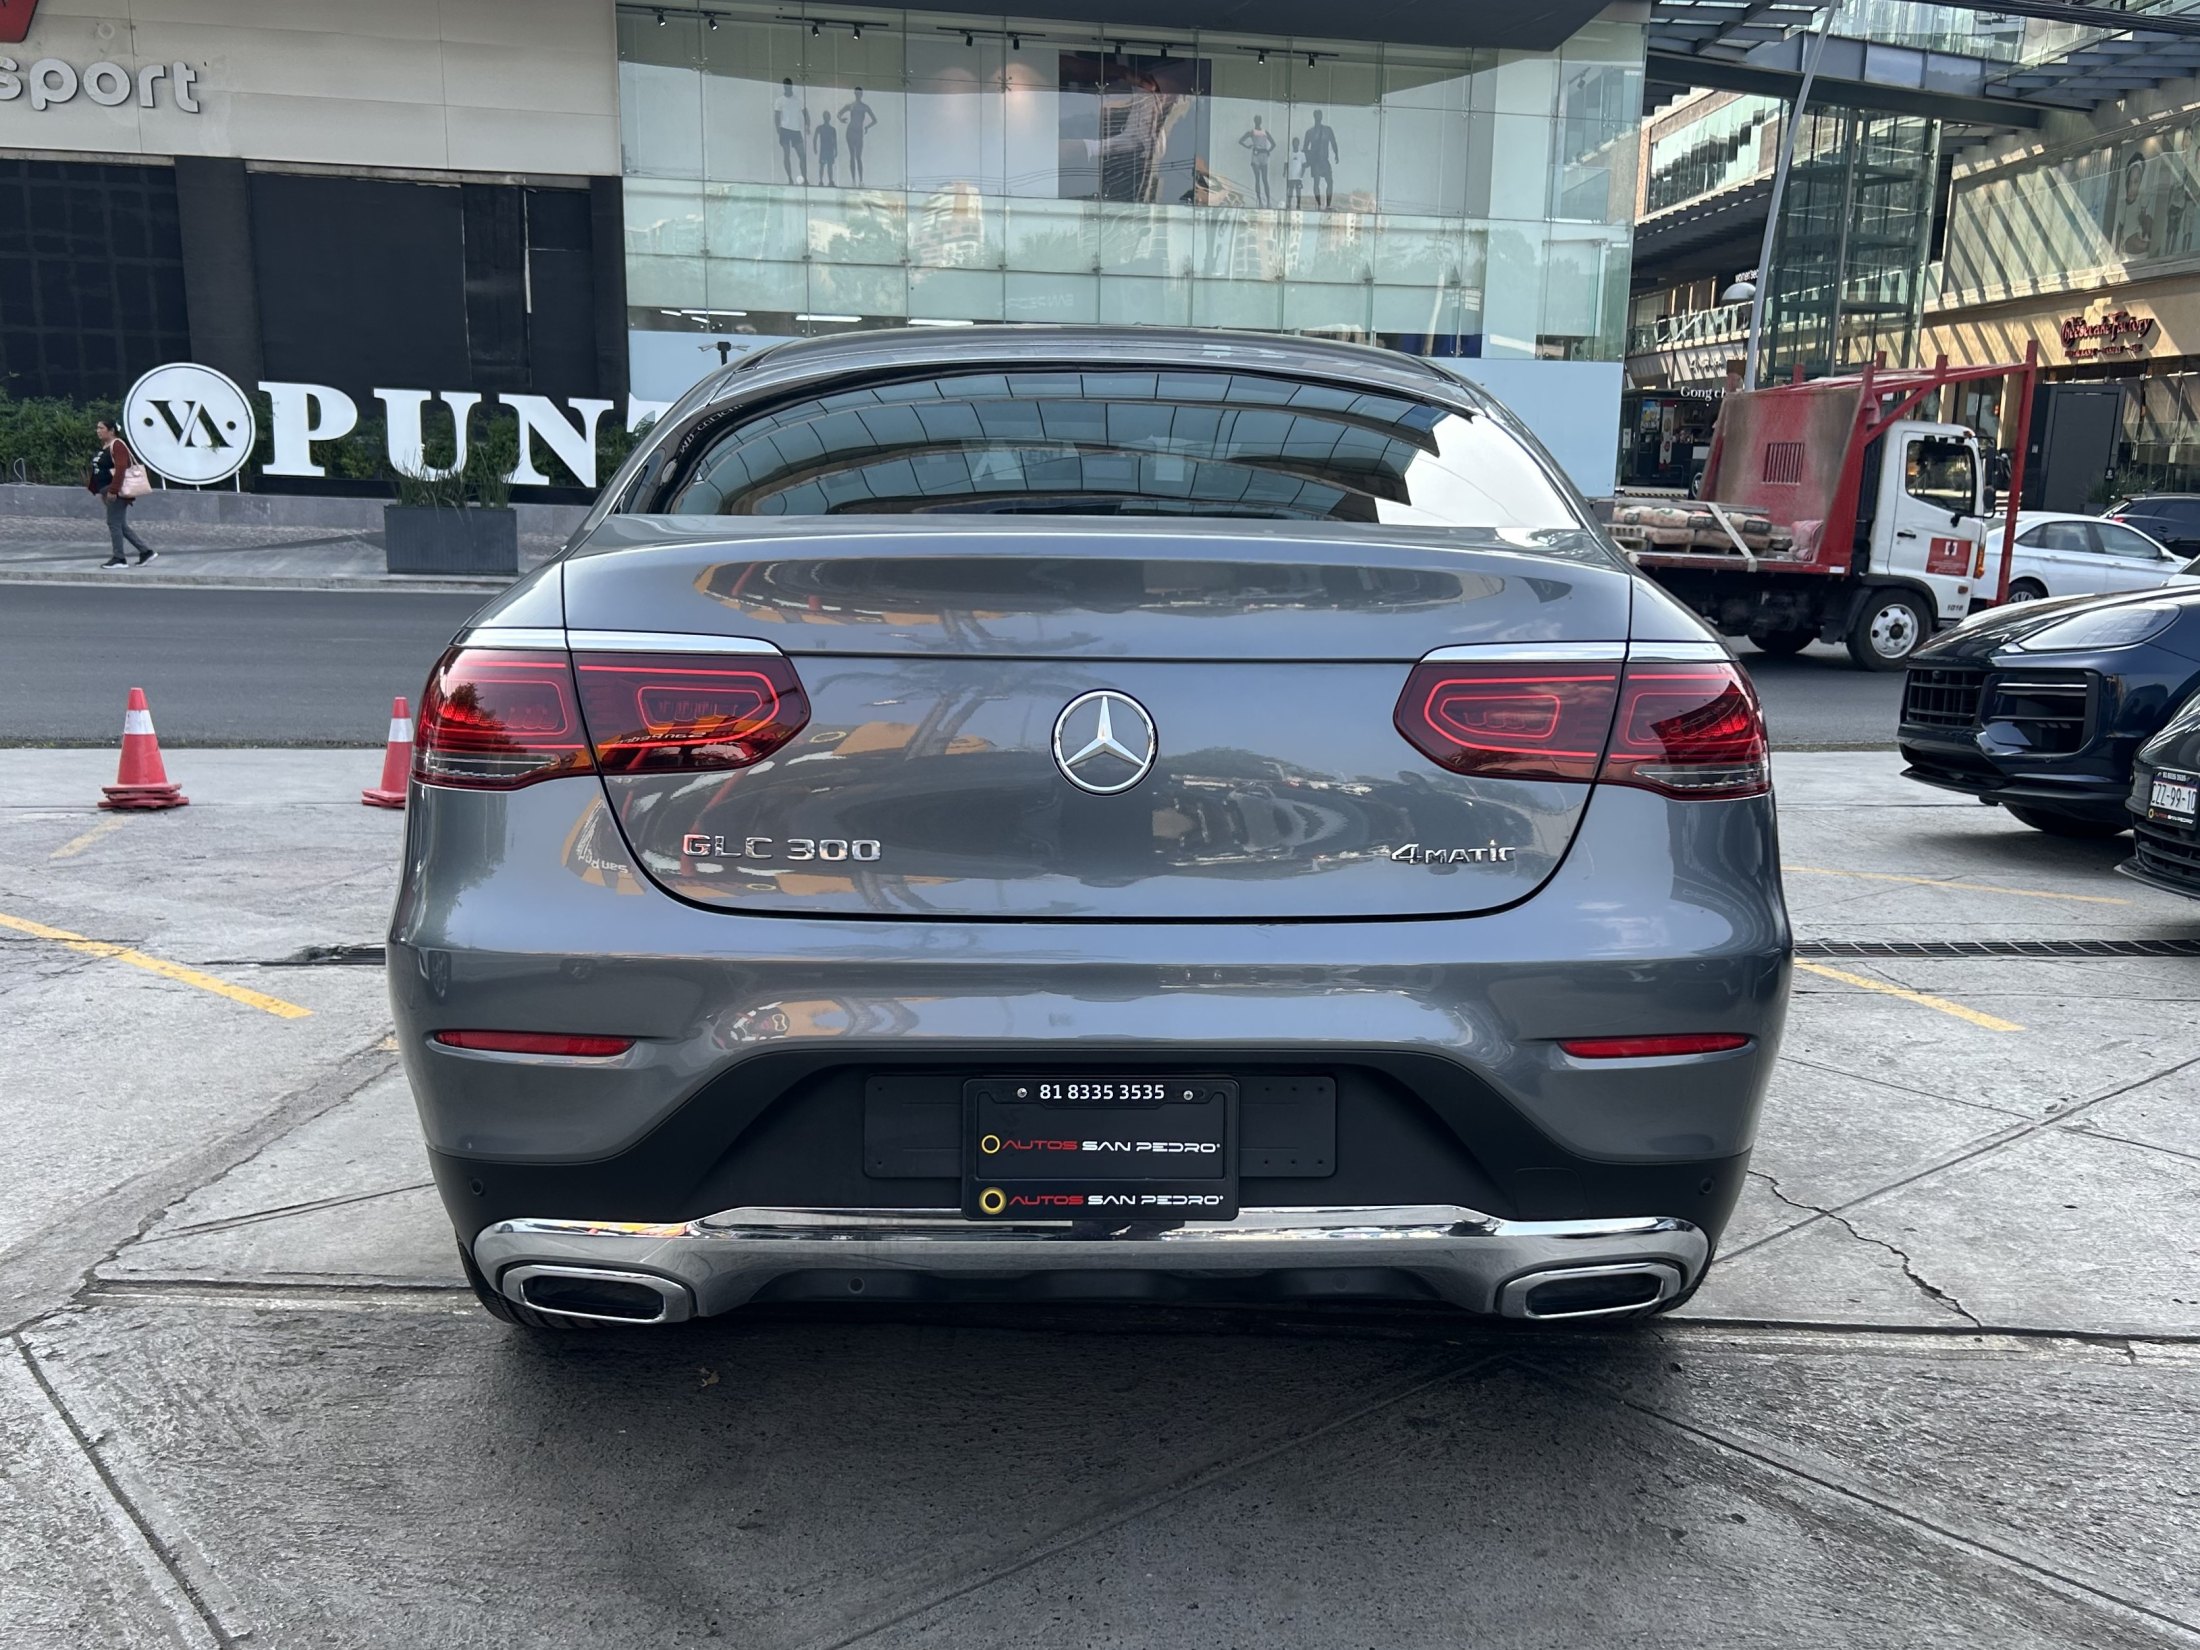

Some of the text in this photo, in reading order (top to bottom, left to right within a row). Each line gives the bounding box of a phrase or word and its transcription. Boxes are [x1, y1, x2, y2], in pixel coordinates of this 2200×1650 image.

[0, 56, 200, 113] sport
[1680, 386, 1712, 402] Gong
[257, 381, 676, 489] PUN
[683, 834, 881, 861] GLC 300
[1040, 1084, 1165, 1100] 81 8335 3535
[1001, 1139, 1217, 1153] AUTOS SAN PEDRO
[1009, 1195, 1219, 1206] AUTOS SAN PEDRO
